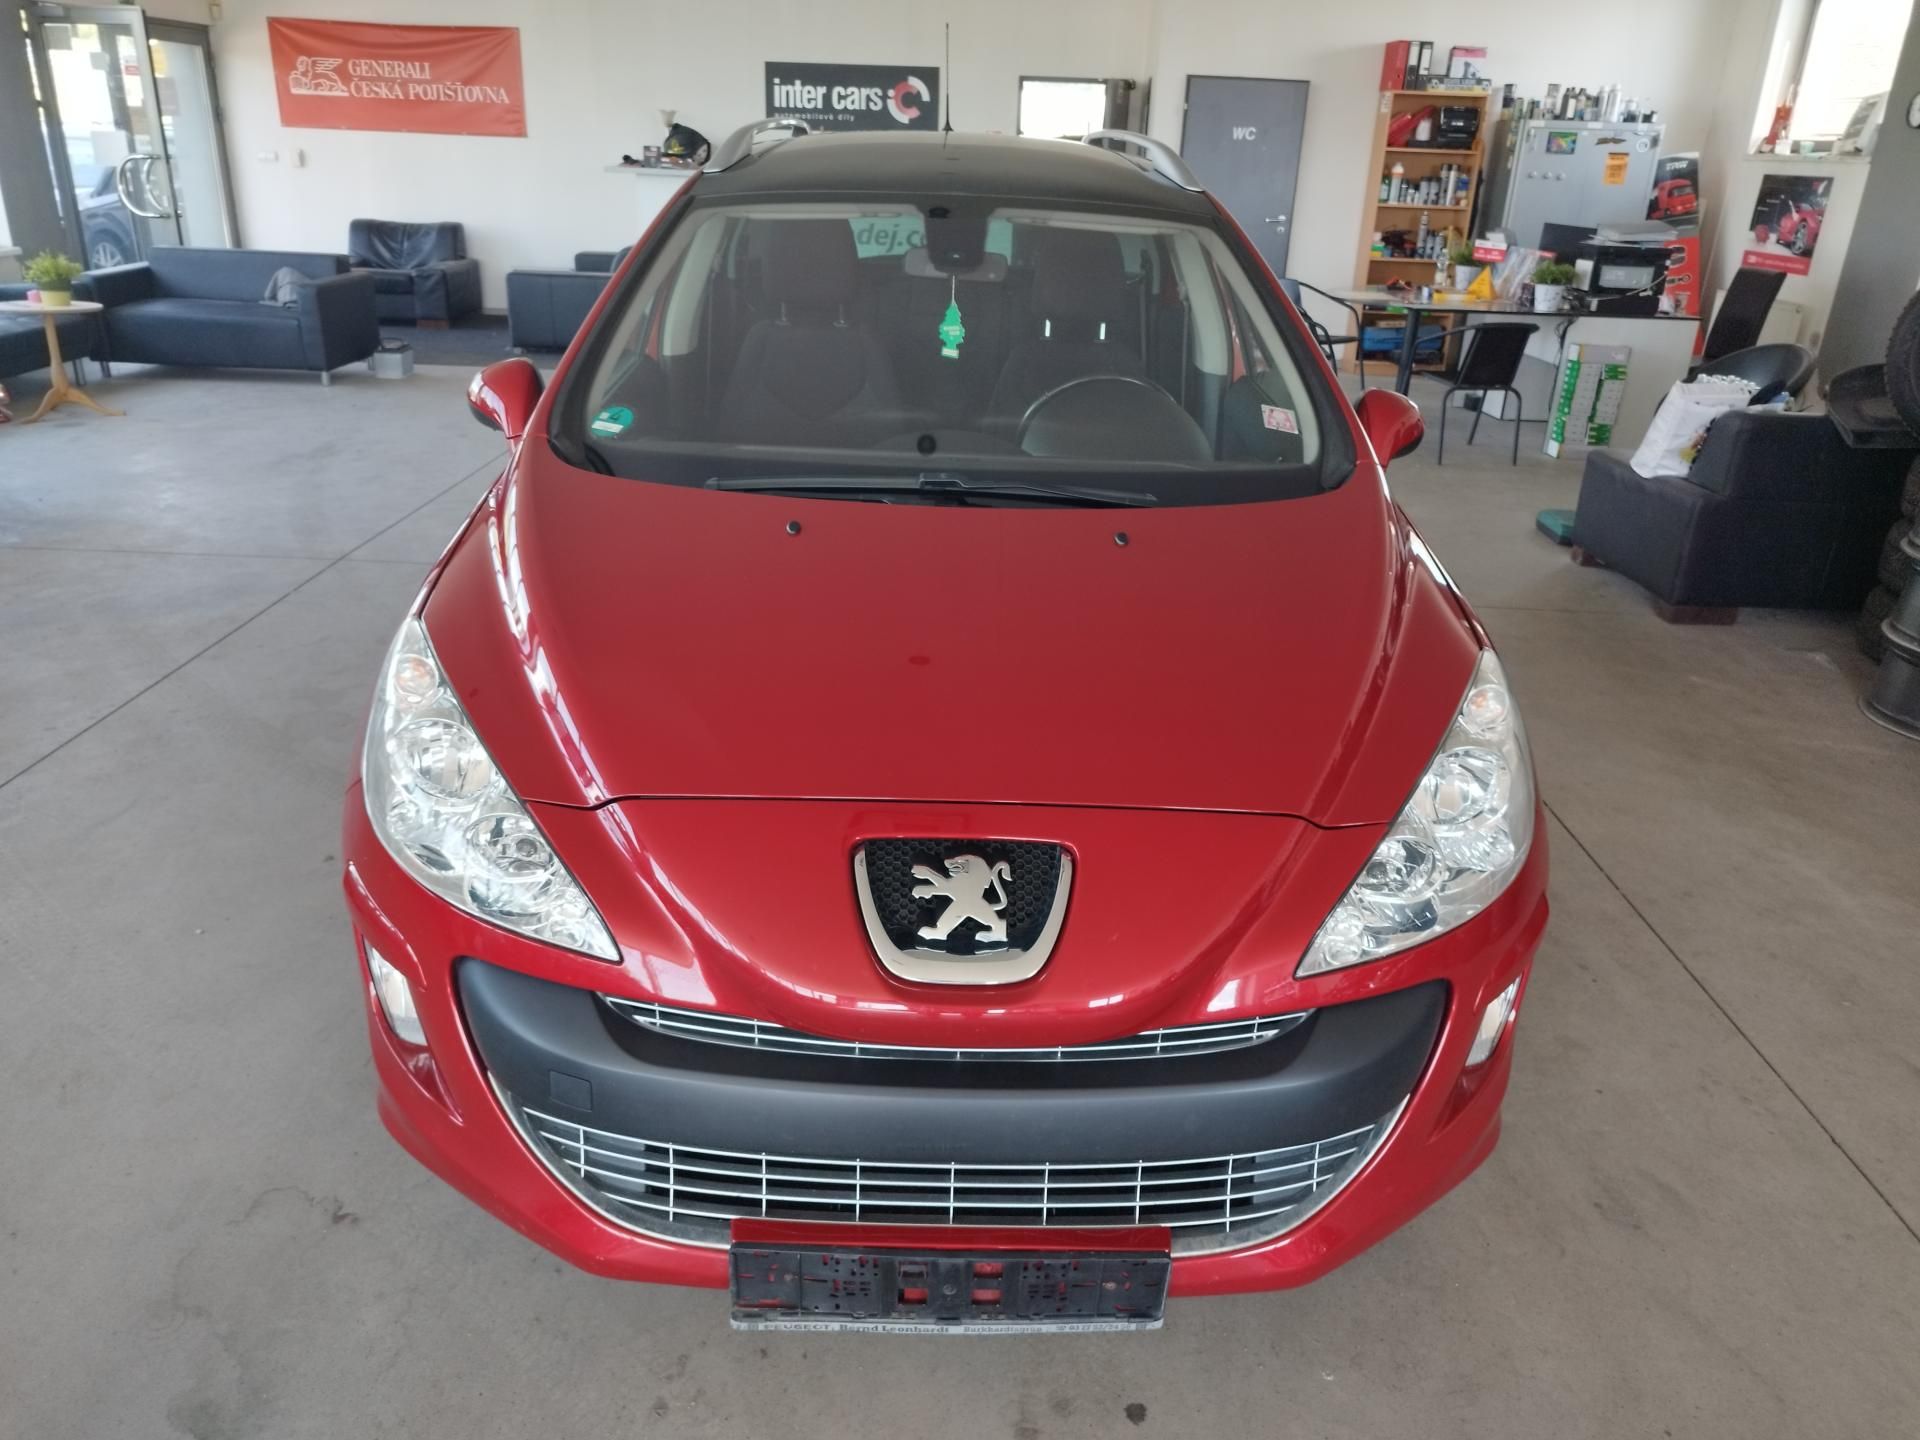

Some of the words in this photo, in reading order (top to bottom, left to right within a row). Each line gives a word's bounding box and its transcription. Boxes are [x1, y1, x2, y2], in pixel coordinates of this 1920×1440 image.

[349, 59, 431, 79] GENERALI
[351, 78, 404, 100] ČESKÁ
[409, 81, 510, 104] POJIŠŤOVNA
[773, 78, 827, 109] inter
[831, 85, 883, 111] cars
[1233, 127, 1257, 140] WC
